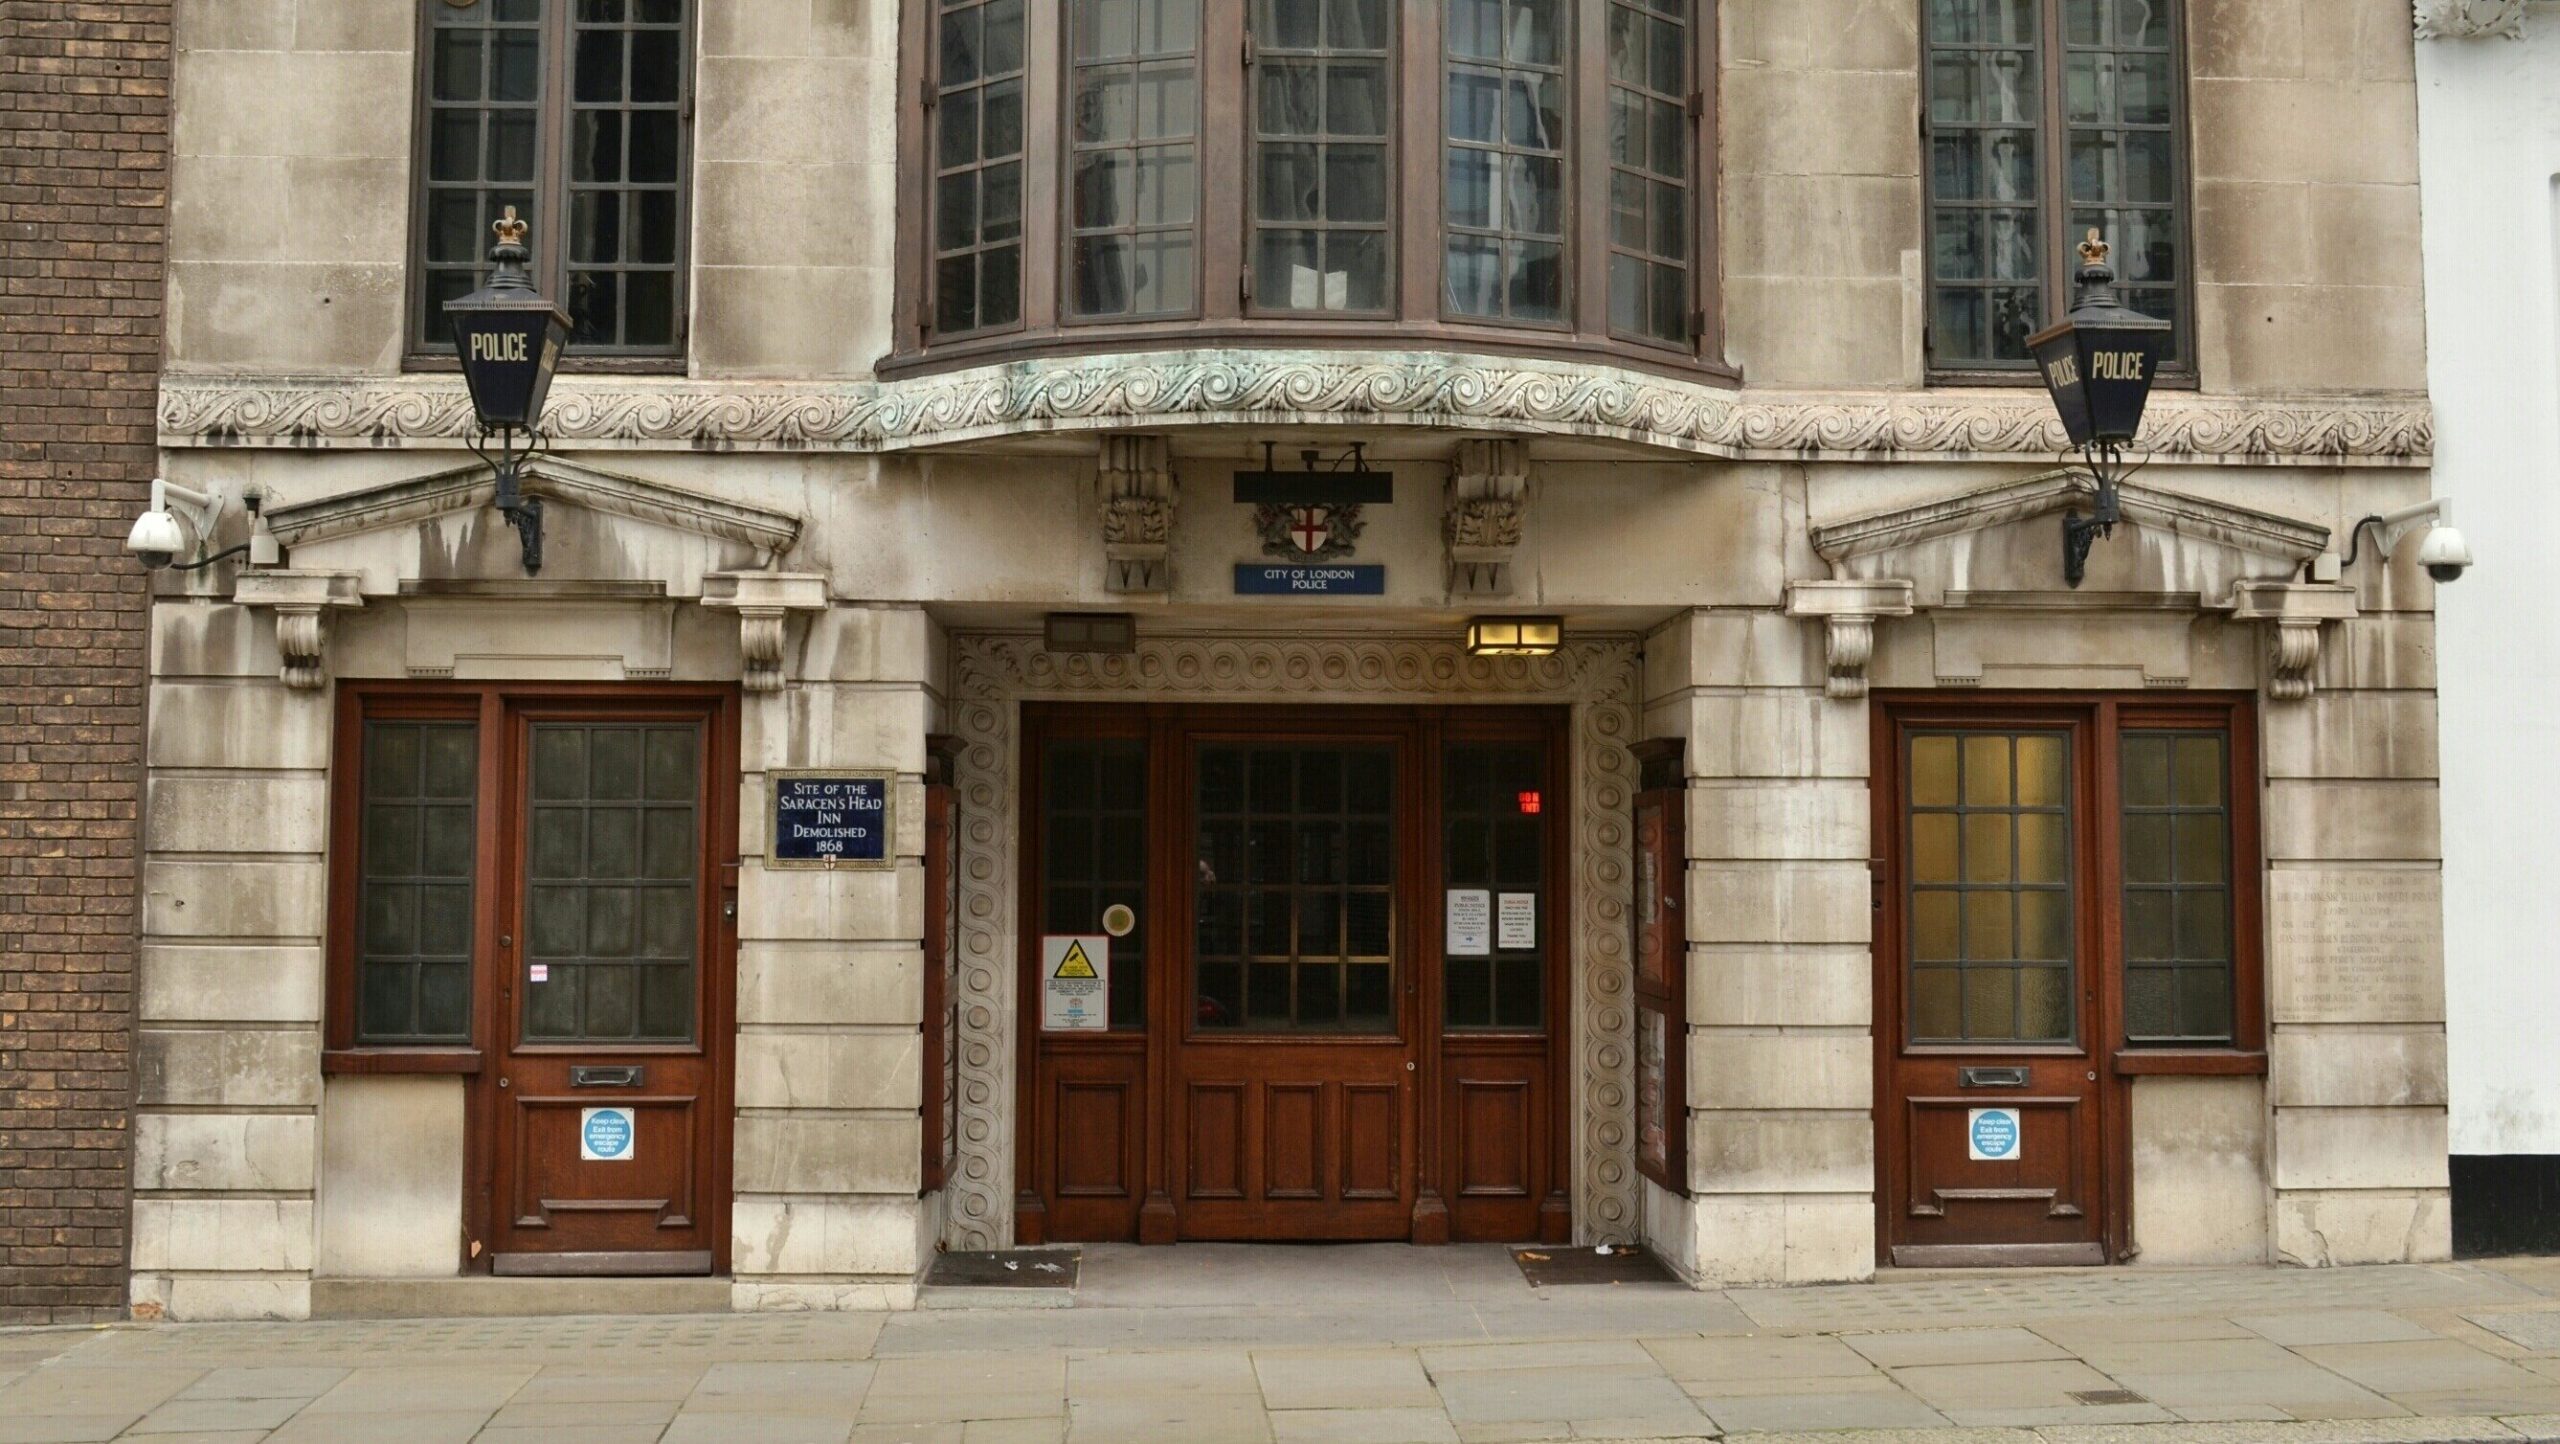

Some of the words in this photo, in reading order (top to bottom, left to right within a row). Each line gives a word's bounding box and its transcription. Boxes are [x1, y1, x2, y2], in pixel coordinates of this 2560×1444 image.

[470, 332, 528, 361] POLICE
[2048, 355, 2080, 390] POLICE
[2092, 351, 2145, 380] POLICE
[1264, 569, 1288, 579] CITY
[1291, 569, 1305, 579] OF
[1309, 569, 1355, 579] LONDON
[1292, 579, 1327, 590] POLICE
[794, 782, 820, 795] SITE
[824, 784, 840, 795] OF
[845, 784, 867, 795] THE
[849, 795, 882, 810] HEAD
[817, 810, 841, 825] INN
[793, 824, 867, 838] DEMOLISHED
[816, 840, 843, 853] 1868
